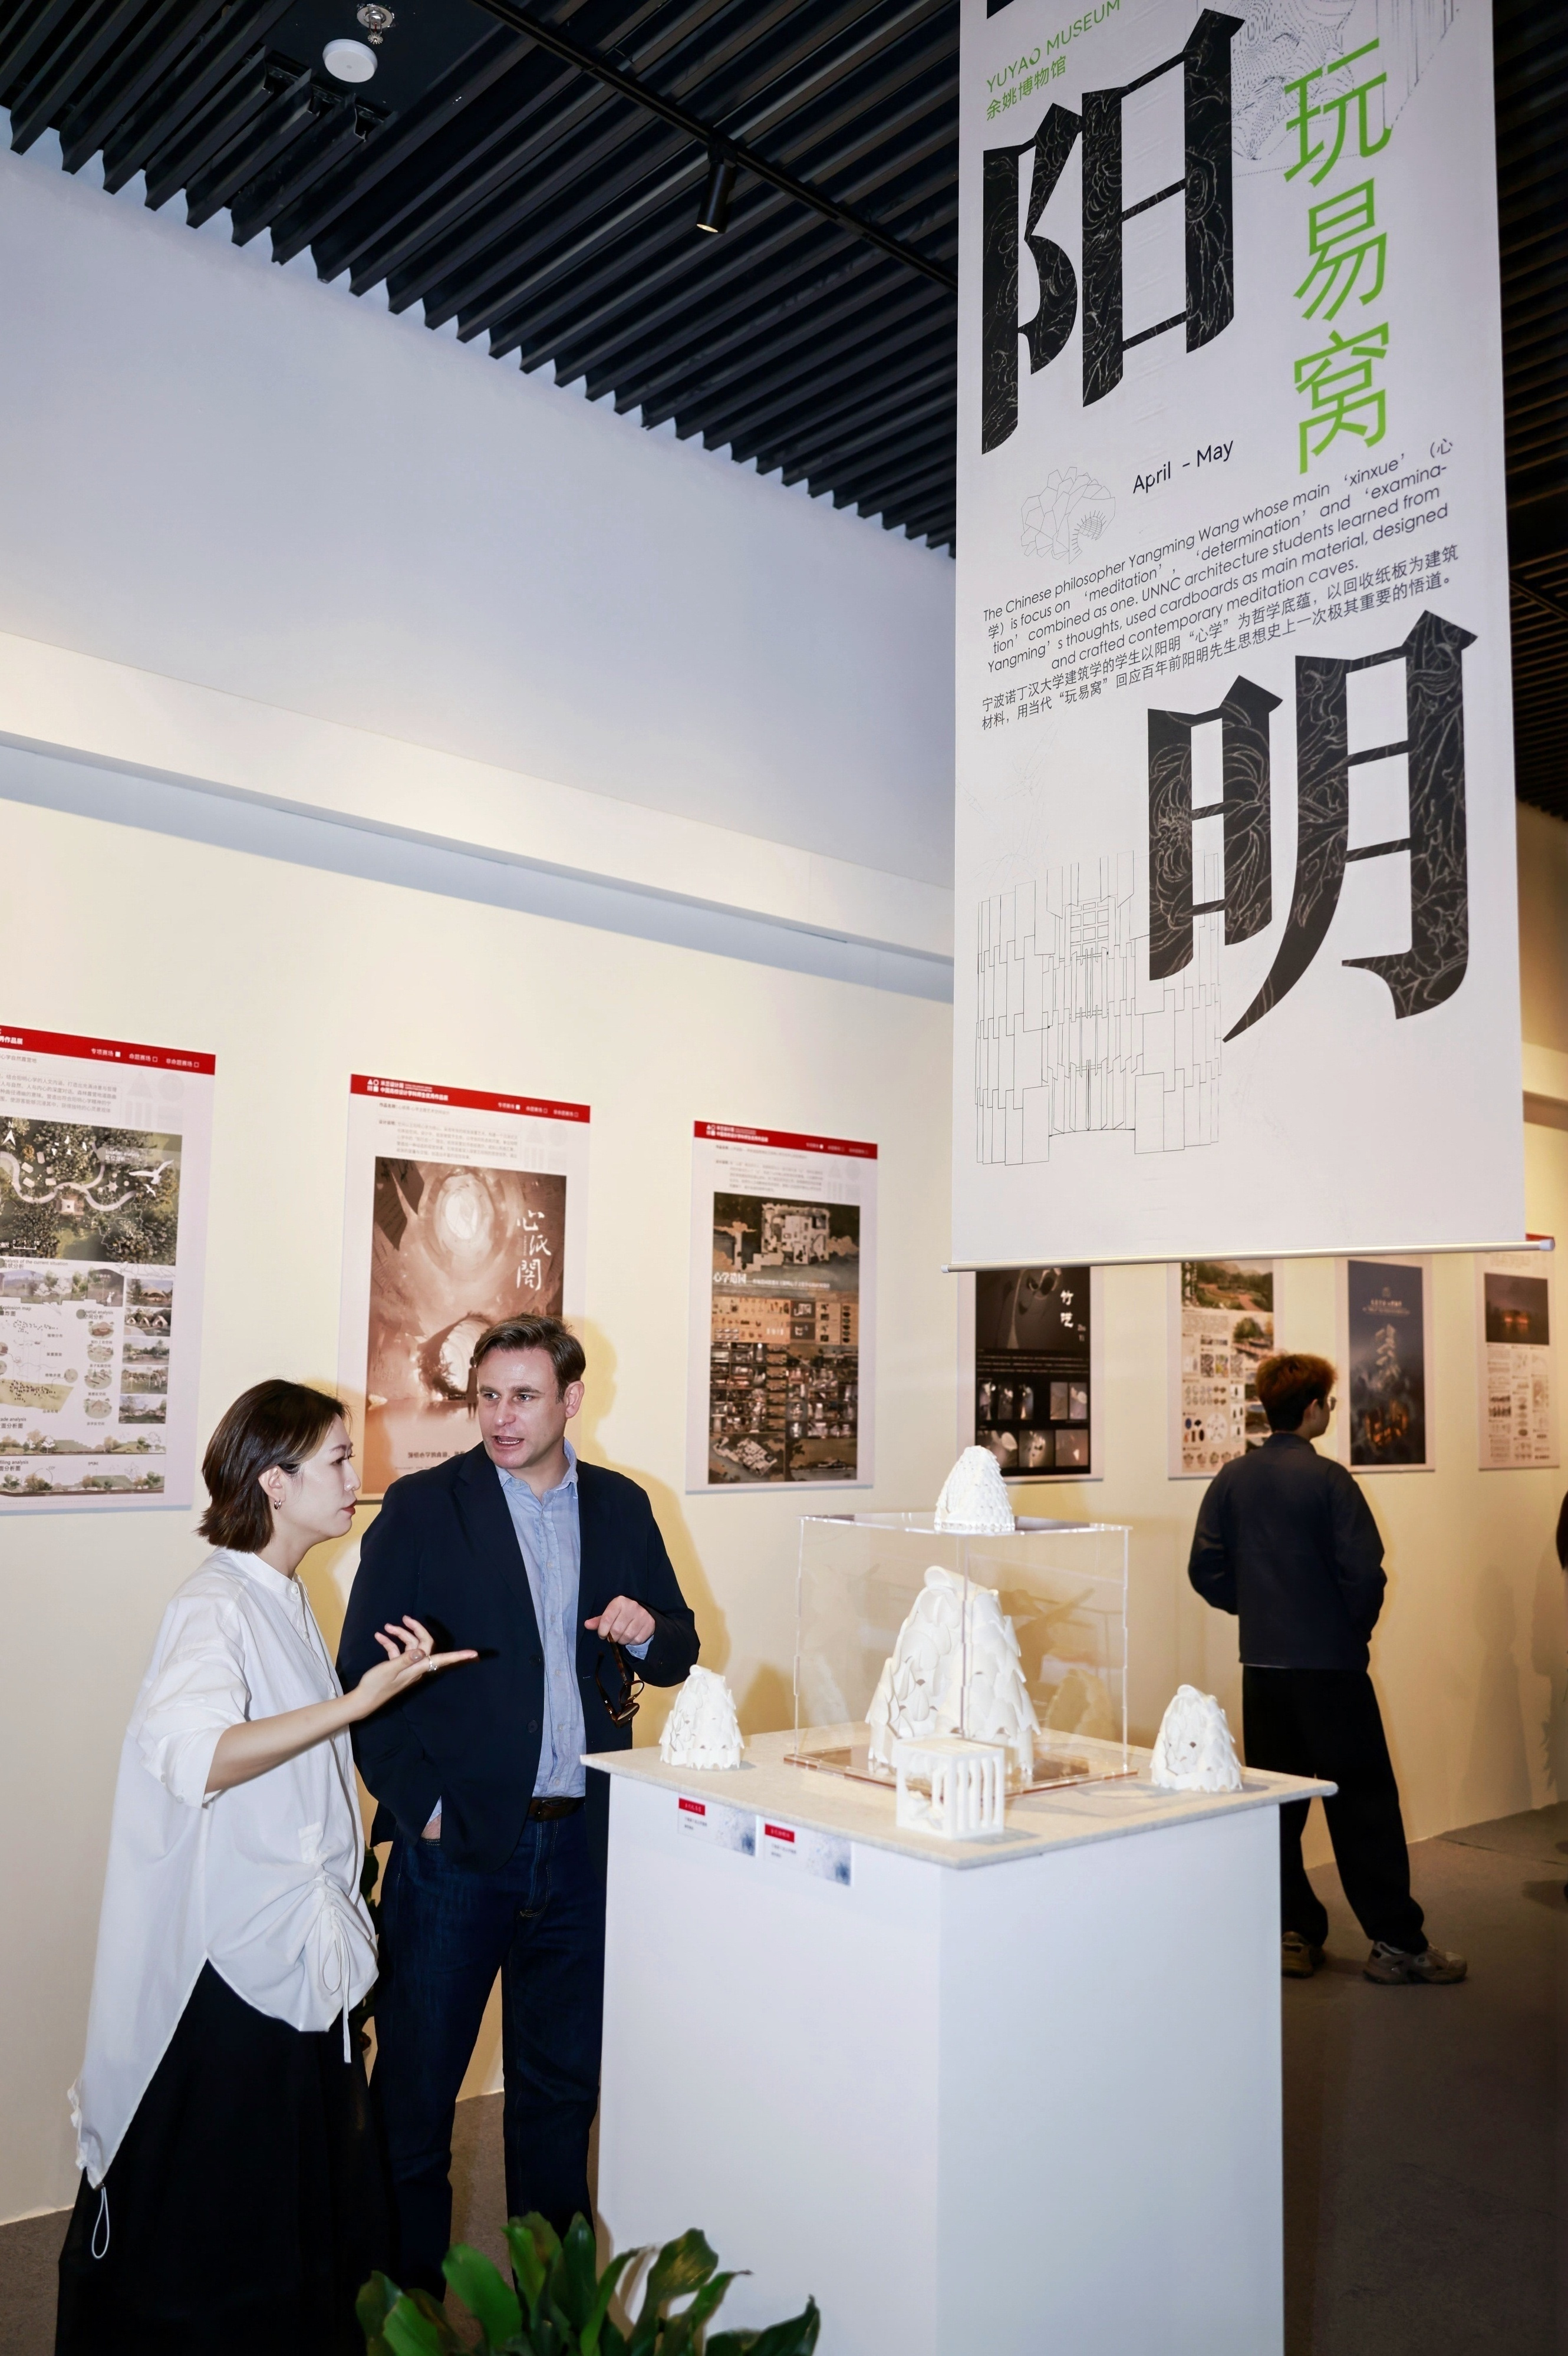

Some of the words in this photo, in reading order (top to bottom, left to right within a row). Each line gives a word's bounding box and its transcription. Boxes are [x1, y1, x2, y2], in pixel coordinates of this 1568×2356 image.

[987, 48, 1040, 93] YUYAO
[1047, 0, 1120, 55] MUSEUM
[987, 55, 1066, 121] 余姚博物馆
[1283, 37, 1392, 474] 玩易窝
[1133, 461, 1171, 493] April
[1197, 440, 1233, 467] May
[984, 608, 1003, 621] The
[1006, 589, 1052, 613] Chinese
[1055, 561, 1126, 597] philosopher
[1129, 535, 1194, 565] Yangming
[1198, 518, 1239, 542] Wang
[1243, 500, 1288, 525] whose
[1293, 485, 1329, 507] main
[1011, 617, 1017, 630] is
[1021, 607, 1052, 627] focus
[1055, 599, 1070, 613] on
[1320, 495, 1350, 516] and
[1028, 608, 1090, 641] combined
[1093, 606, 1107, 618] as
[1110, 598, 1138, 613] one.
[1142, 577, 1181, 602] UNNC
[1185, 548, 1268, 586] architecture
[1273, 523, 1333, 555] students
[1338, 499, 1398, 532] learned
[1403, 487, 1439, 509] from
[1052, 651, 1075, 669] and
[1079, 635, 1125, 660] crafted
[1128, 603, 1223, 644] contemporary
[1227, 575, 1304, 611] meditation
[1309, 559, 1358, 583] caves.
[1066, 619, 1122, 645] thoughts,
[1126, 605, 1156, 625] used
[1159, 577, 1238, 614] cardboards
[1243, 571, 1257, 585] as
[1262, 557, 1297, 579] main
[1302, 532, 1368, 564] material,
[1373, 503, 1448, 541] designed
[1148, 609, 1478, 1042] 明
